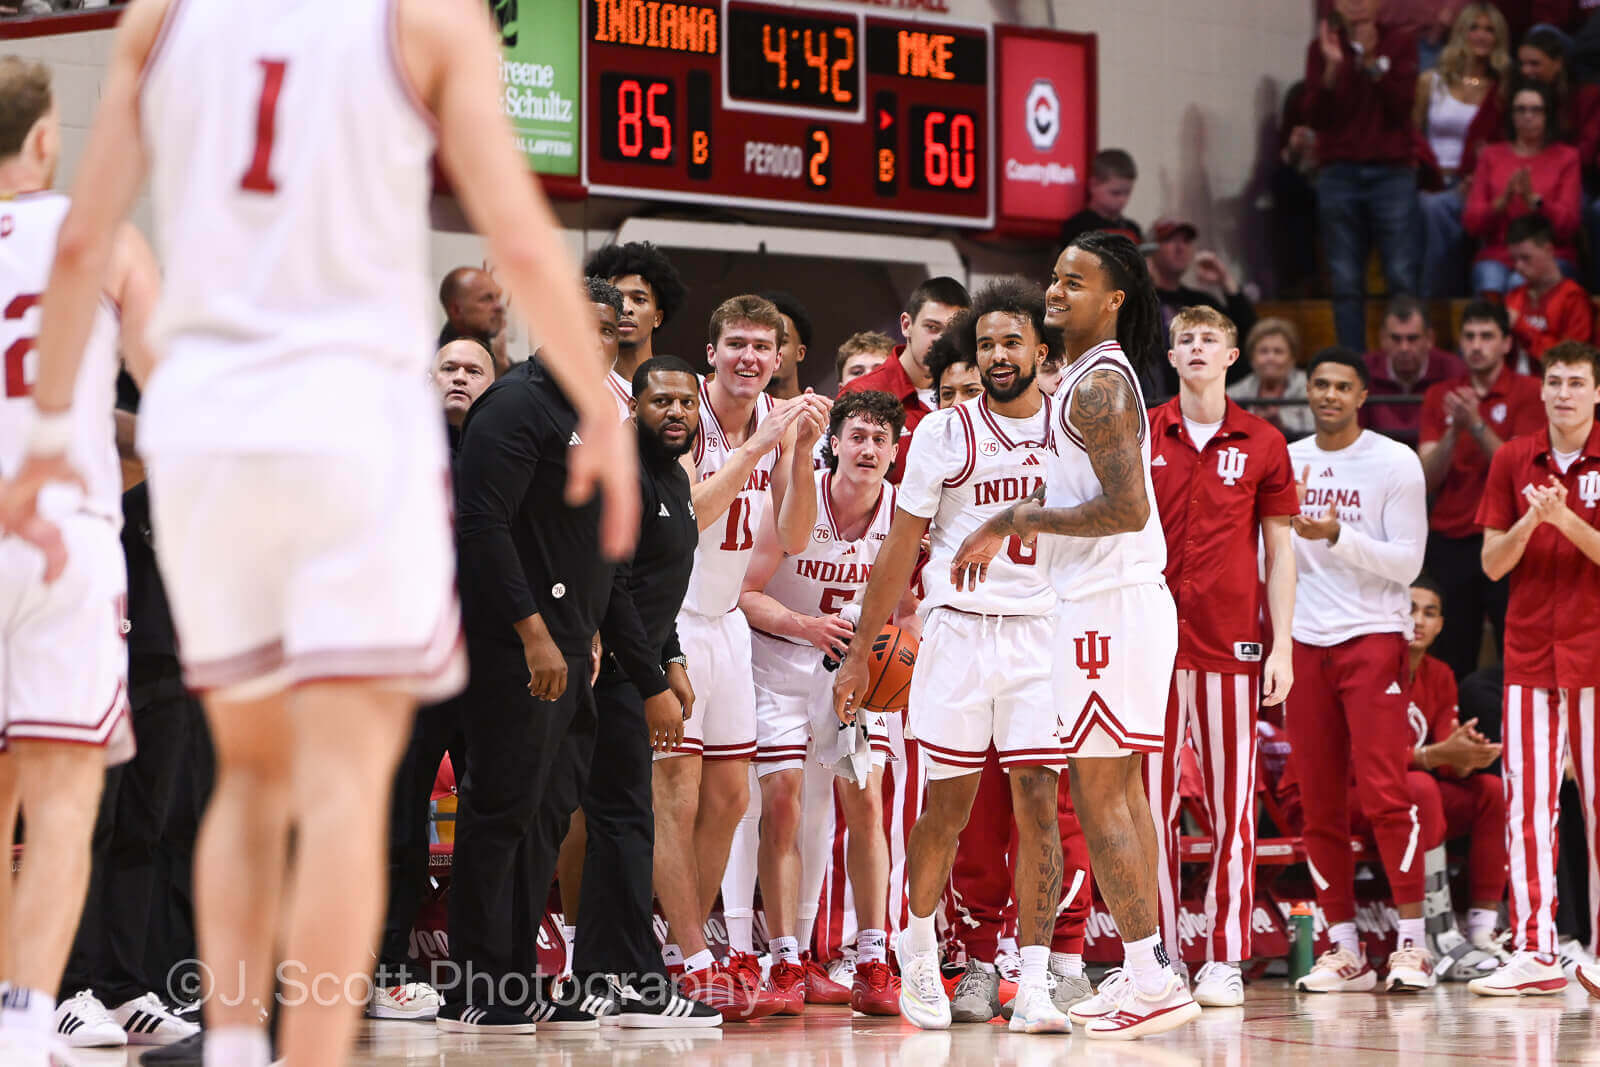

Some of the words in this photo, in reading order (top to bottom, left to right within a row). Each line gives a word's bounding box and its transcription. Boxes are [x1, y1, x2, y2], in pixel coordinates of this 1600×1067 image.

[594, 0, 717, 54] INDIANA
[497, 55, 554, 88] reene
[763, 24, 854, 102] 4:42
[898, 30, 955, 80] MKE
[240, 58, 289, 193] 1
[506, 86, 574, 123] Schultz
[618, 80, 671, 160] 85
[745, 141, 803, 179] PERIOD
[809, 130, 829, 186] 2
[924, 112, 975, 188] 60
[974, 476, 1047, 506] INDIA
[1305, 489, 1361, 508] DIANA
[720, 496, 753, 551] 11
[815, 528, 829, 540] 76
[796, 559, 873, 583] INDIAN
